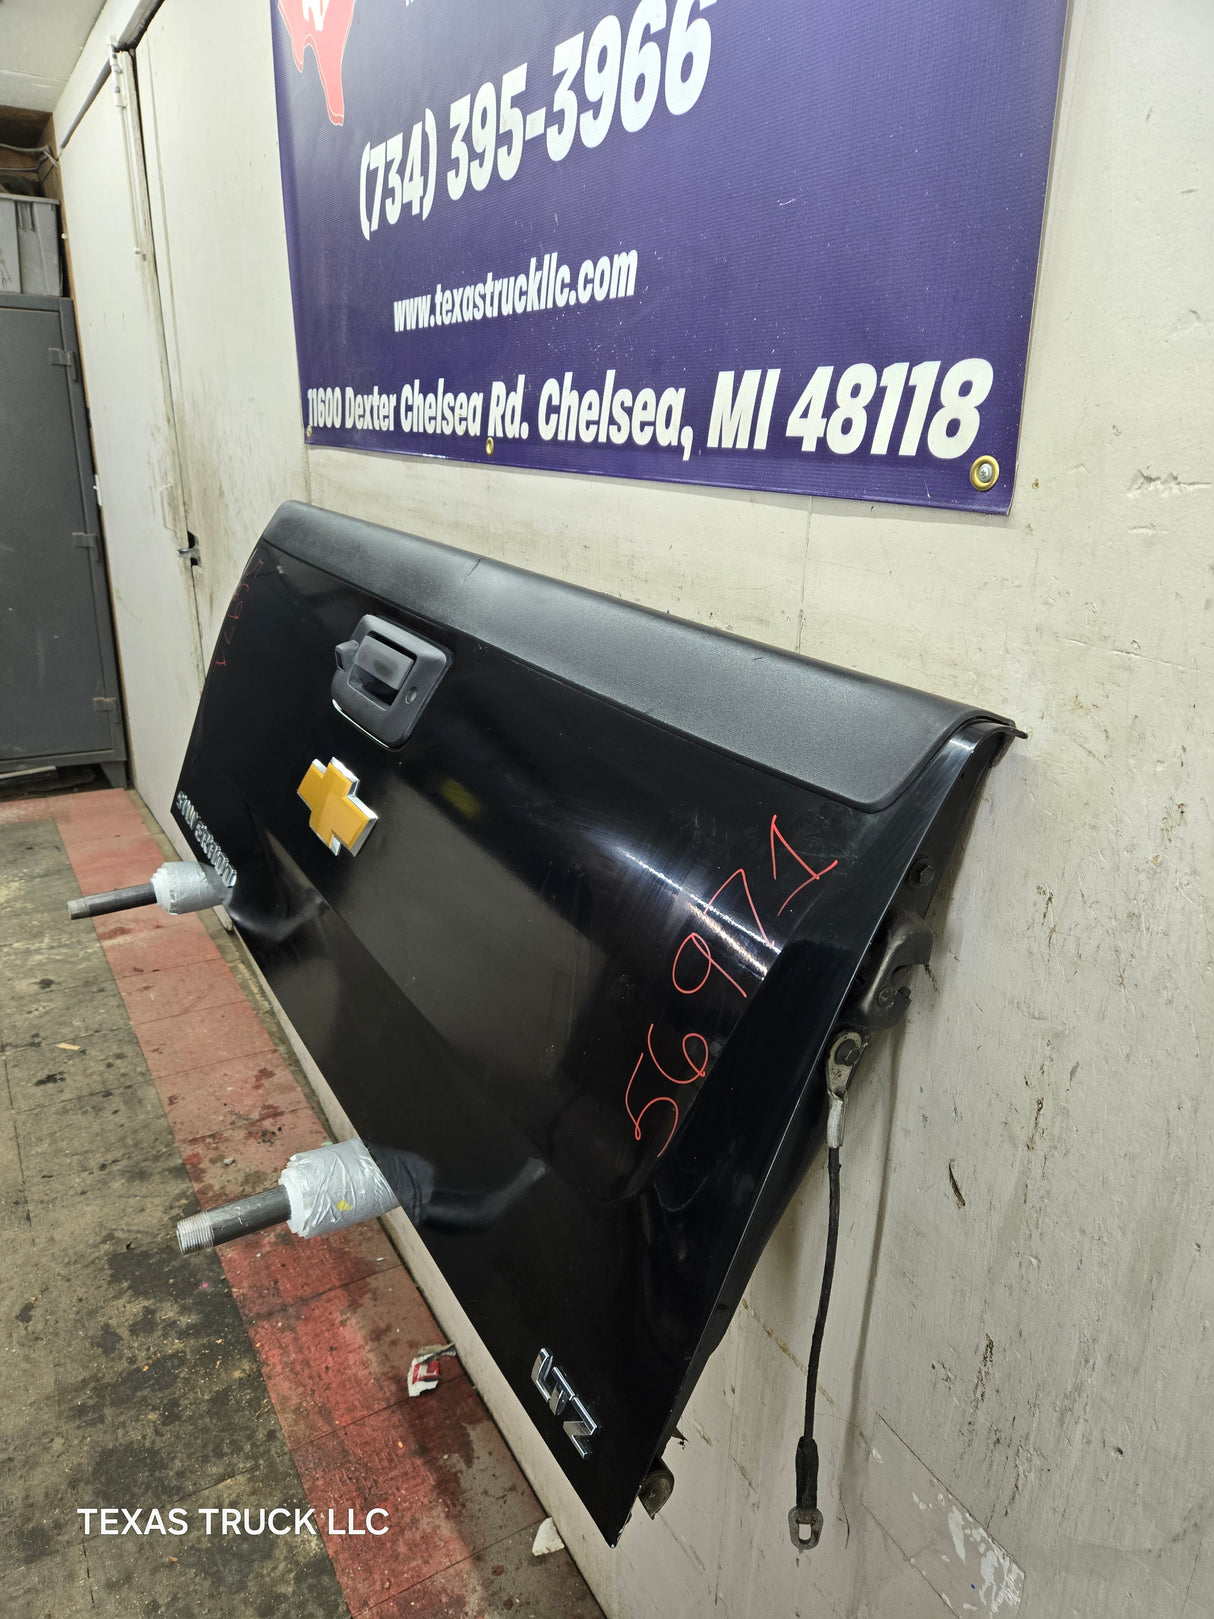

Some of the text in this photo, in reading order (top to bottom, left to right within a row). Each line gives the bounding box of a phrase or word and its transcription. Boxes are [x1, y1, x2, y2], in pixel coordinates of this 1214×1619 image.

[360, 0, 718, 240] (734) 395-3966
[393, 249, 638, 332] www.texastruckllc.com
[307, 358, 994, 461] 11600 Dexter Chelsea Rd. Chelsea, MI 48118
[625, 814, 839, 1158] 56971
[530, 1347, 598, 1460] LTZ
